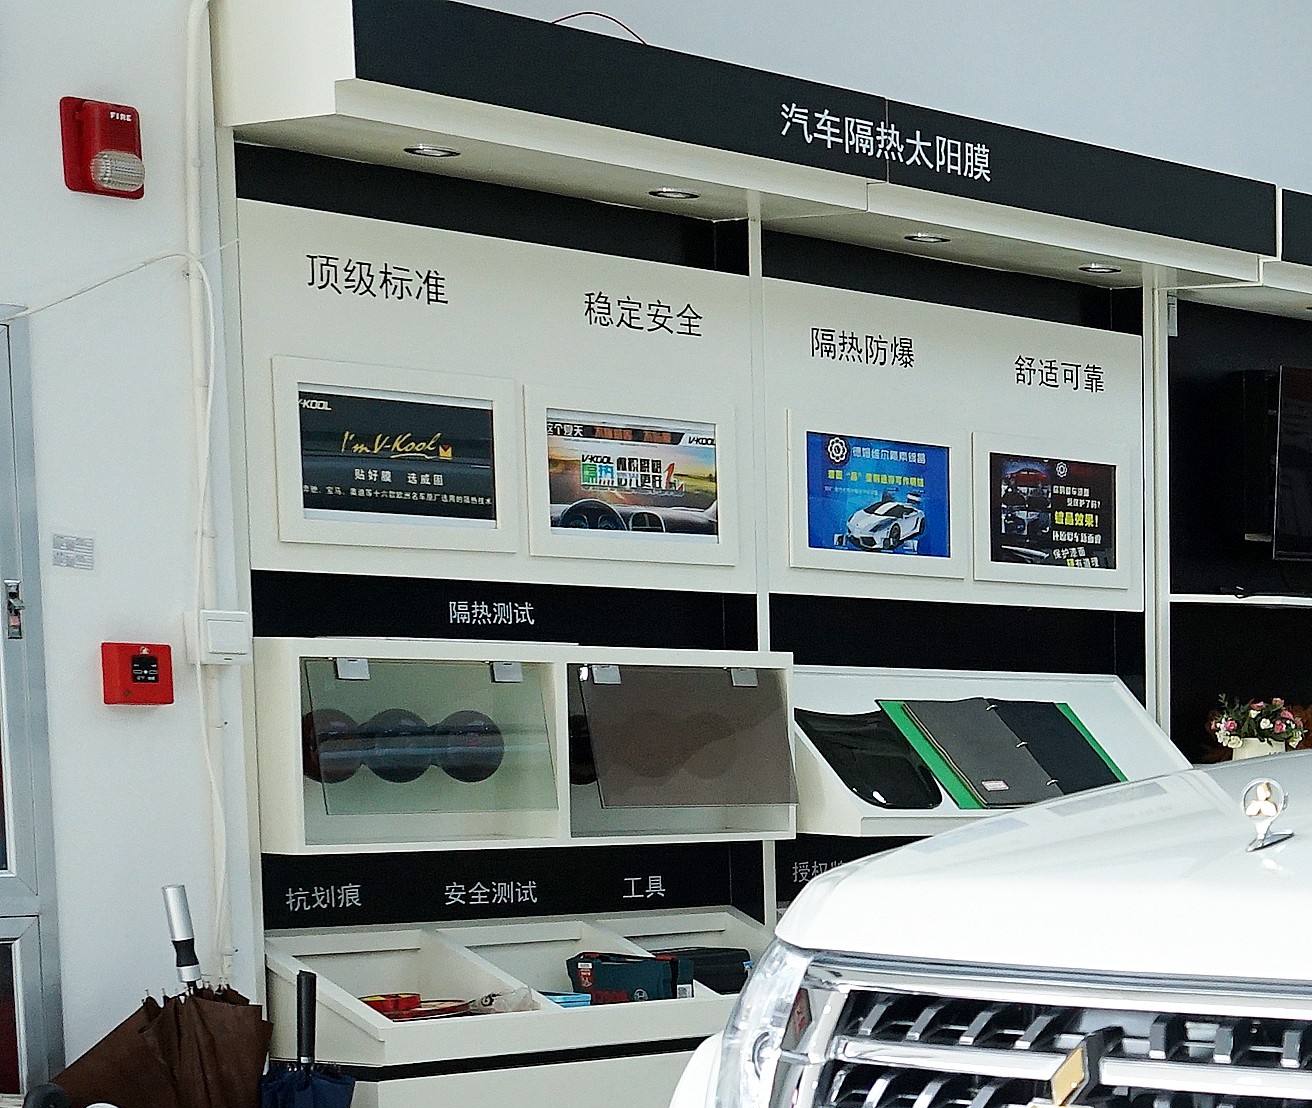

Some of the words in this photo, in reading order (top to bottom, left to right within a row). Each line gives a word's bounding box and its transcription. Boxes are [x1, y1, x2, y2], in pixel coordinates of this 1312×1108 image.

[109, 111, 132, 122] FIRE
[780, 102, 992, 183] 汽车隔热太阳膜
[305, 253, 449, 306] 顶级标准
[583, 290, 703, 338] 稳定安全
[810, 326, 915, 369] 隔热防爆
[1014, 354, 1105, 393] 舒适可靠
[354, 467, 393, 483] 贴好膜
[448, 600, 535, 625] 隔热测试
[792, 859, 844, 883] 授权
[285, 882, 362, 912] 抗划痕
[443, 880, 538, 906] 安全测试
[622, 874, 667, 900] 工具
